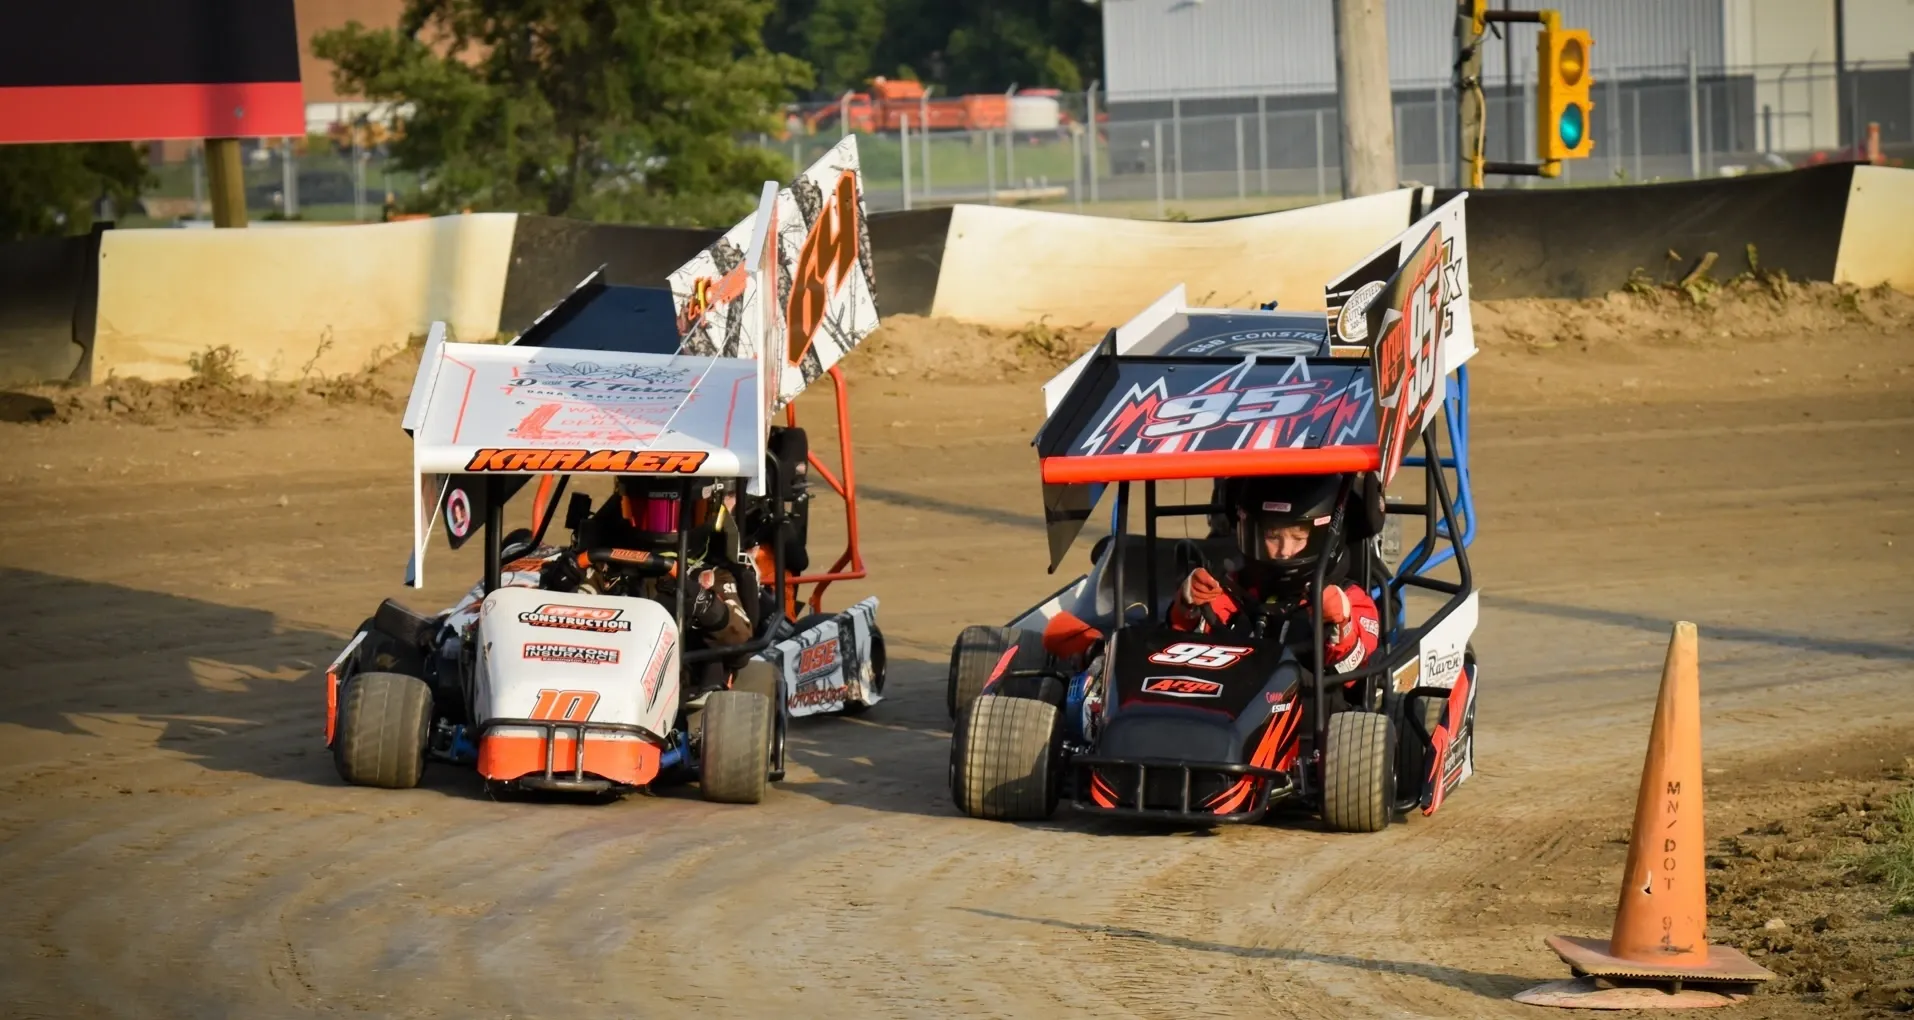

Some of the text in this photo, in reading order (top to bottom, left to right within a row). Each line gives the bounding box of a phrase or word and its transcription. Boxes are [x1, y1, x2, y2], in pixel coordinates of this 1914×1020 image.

[787, 169, 859, 367] 64
[1406, 266, 1441, 416] 95
[1140, 379, 1330, 440] 95
[464, 448, 710, 474] KRAMER
[519, 612, 630, 630] CONSTRUCTION
[525, 645, 618, 657] RUNESTONE
[525, 650, 617, 663] INSURANCE
[1149, 642, 1252, 669] 95
[1151, 679, 1220, 693] Argo
[528, 689, 600, 722] 10
